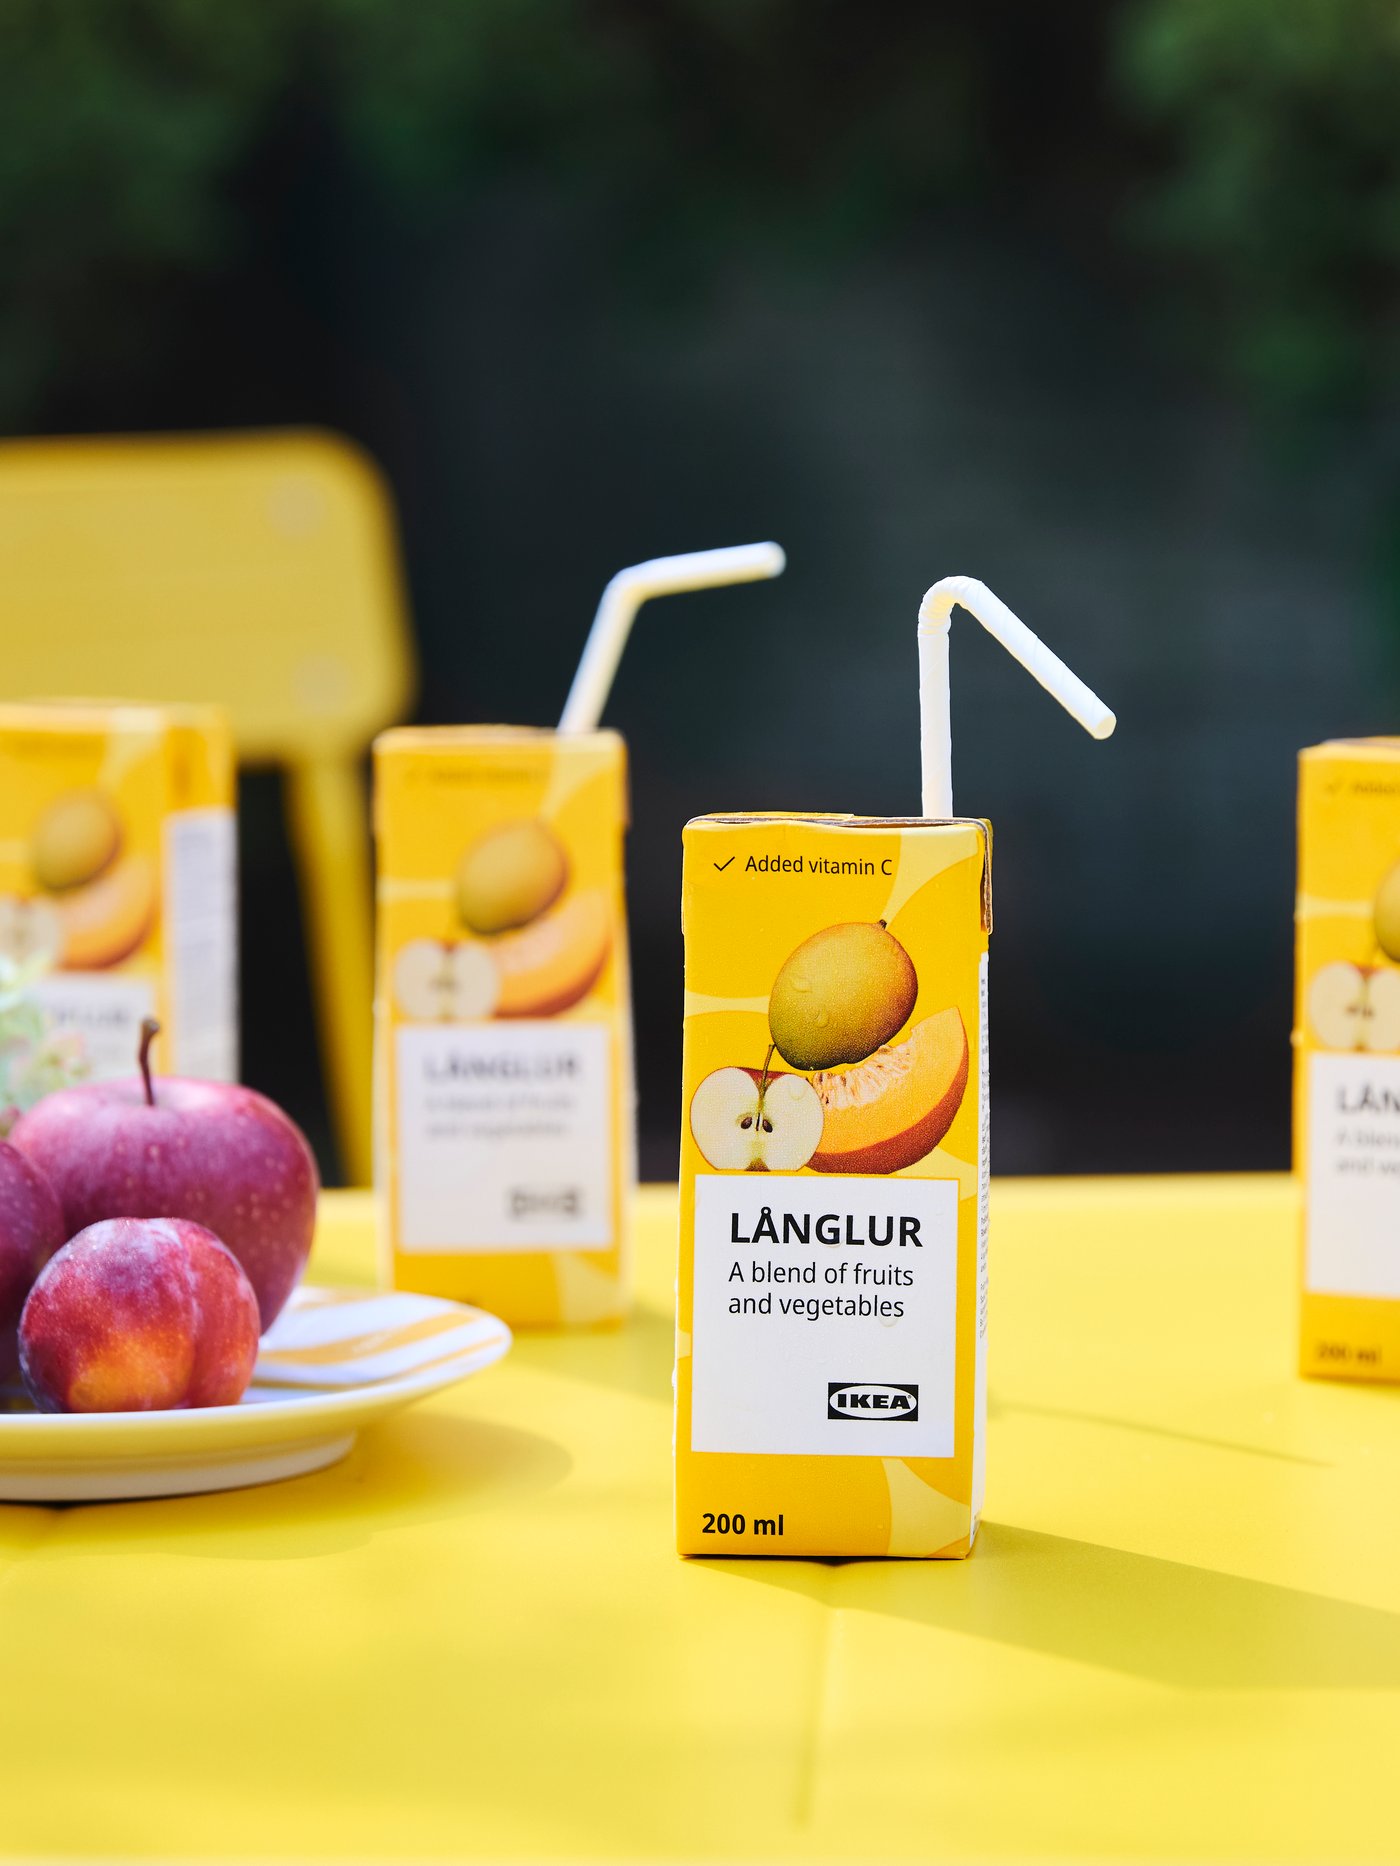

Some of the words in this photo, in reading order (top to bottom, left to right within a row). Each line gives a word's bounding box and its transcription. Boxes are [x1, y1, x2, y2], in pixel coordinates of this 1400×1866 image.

[745, 855, 803, 873] Added
[808, 857, 875, 875] vitamin
[881, 859, 892, 876] C
[731, 1206, 923, 1248] LÅNGLUR
[728, 1261, 744, 1283] A
[752, 1260, 816, 1284] blend
[824, 1262, 849, 1285] of
[852, 1262, 914, 1287] fruits
[728, 1292, 772, 1315] and
[778, 1293, 904, 1321] vegetables
[837, 1393, 911, 1410] IKEA
[702, 1512, 746, 1535] 200
[753, 1514, 784, 1536] ml
